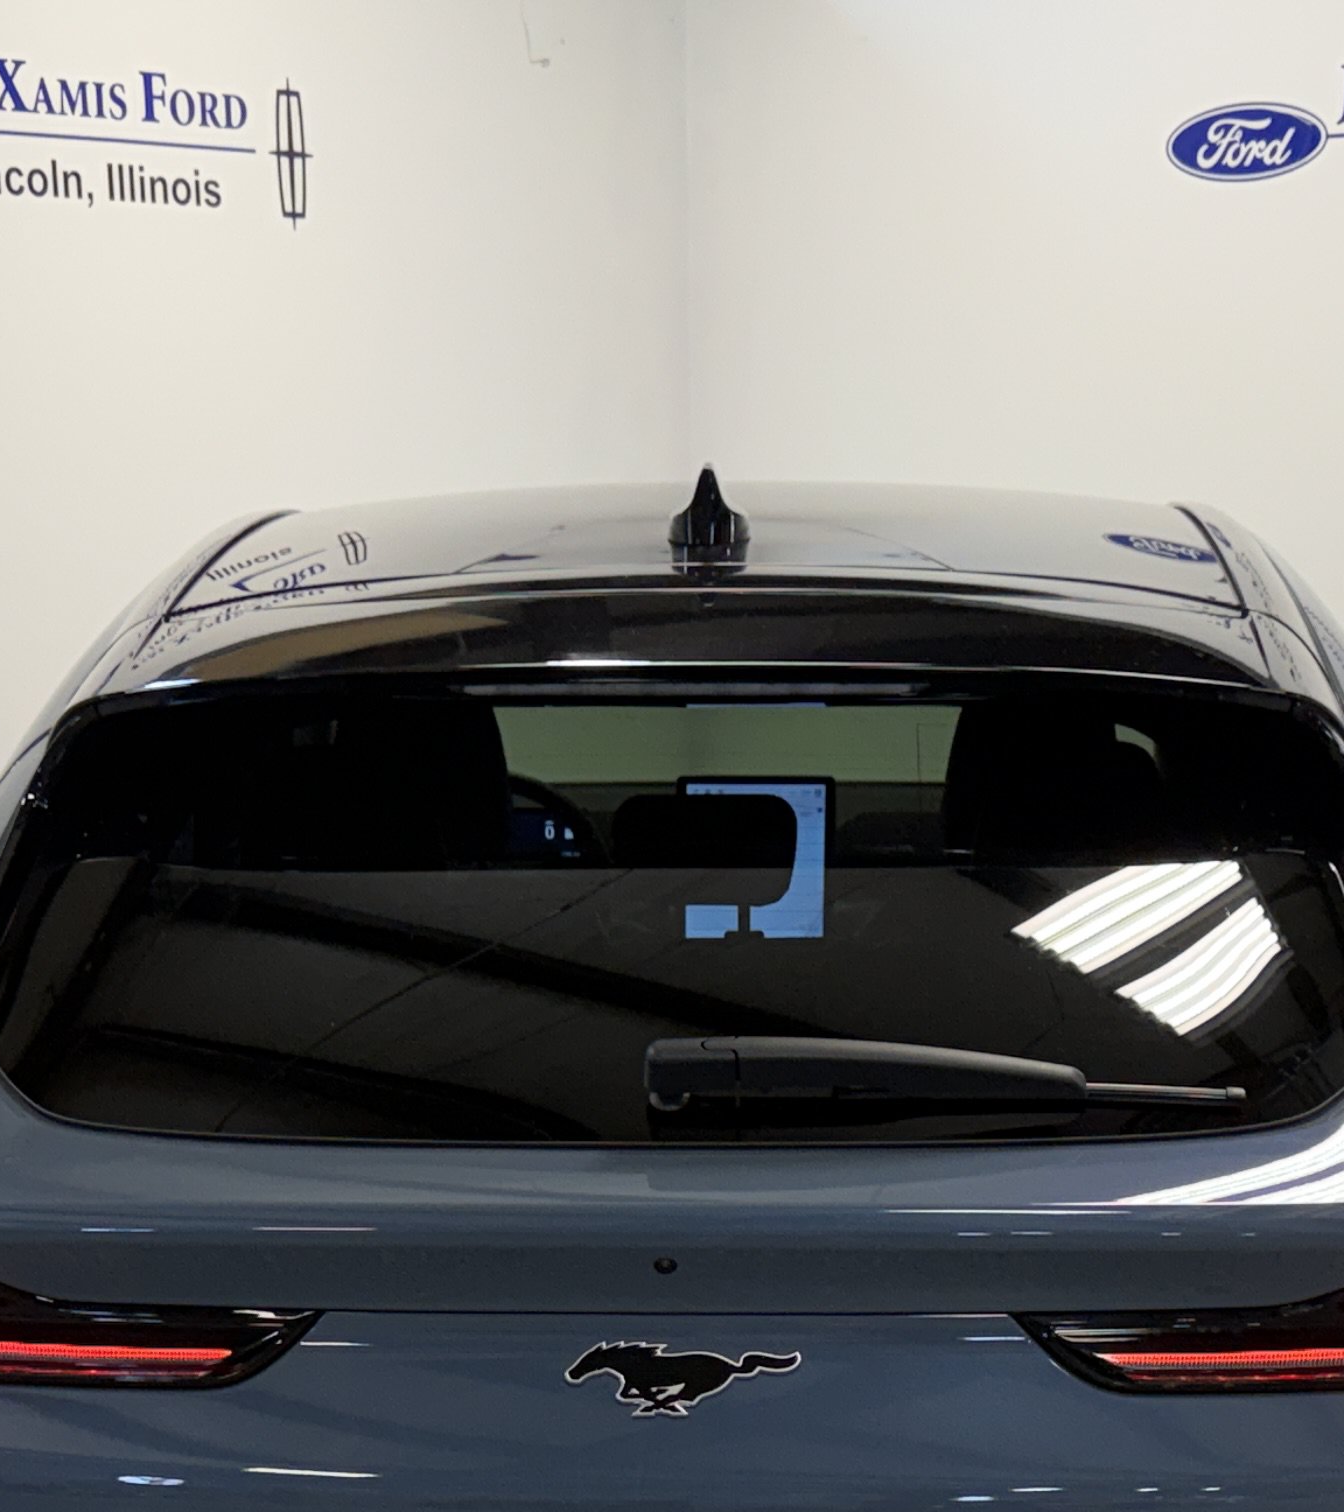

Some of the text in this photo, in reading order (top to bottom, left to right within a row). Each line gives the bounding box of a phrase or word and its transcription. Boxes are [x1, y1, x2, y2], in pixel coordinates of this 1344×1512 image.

[139, 70, 248, 131] FORD
[1196, 116, 1293, 170] Ford
[107, 162, 222, 208] Illinois
